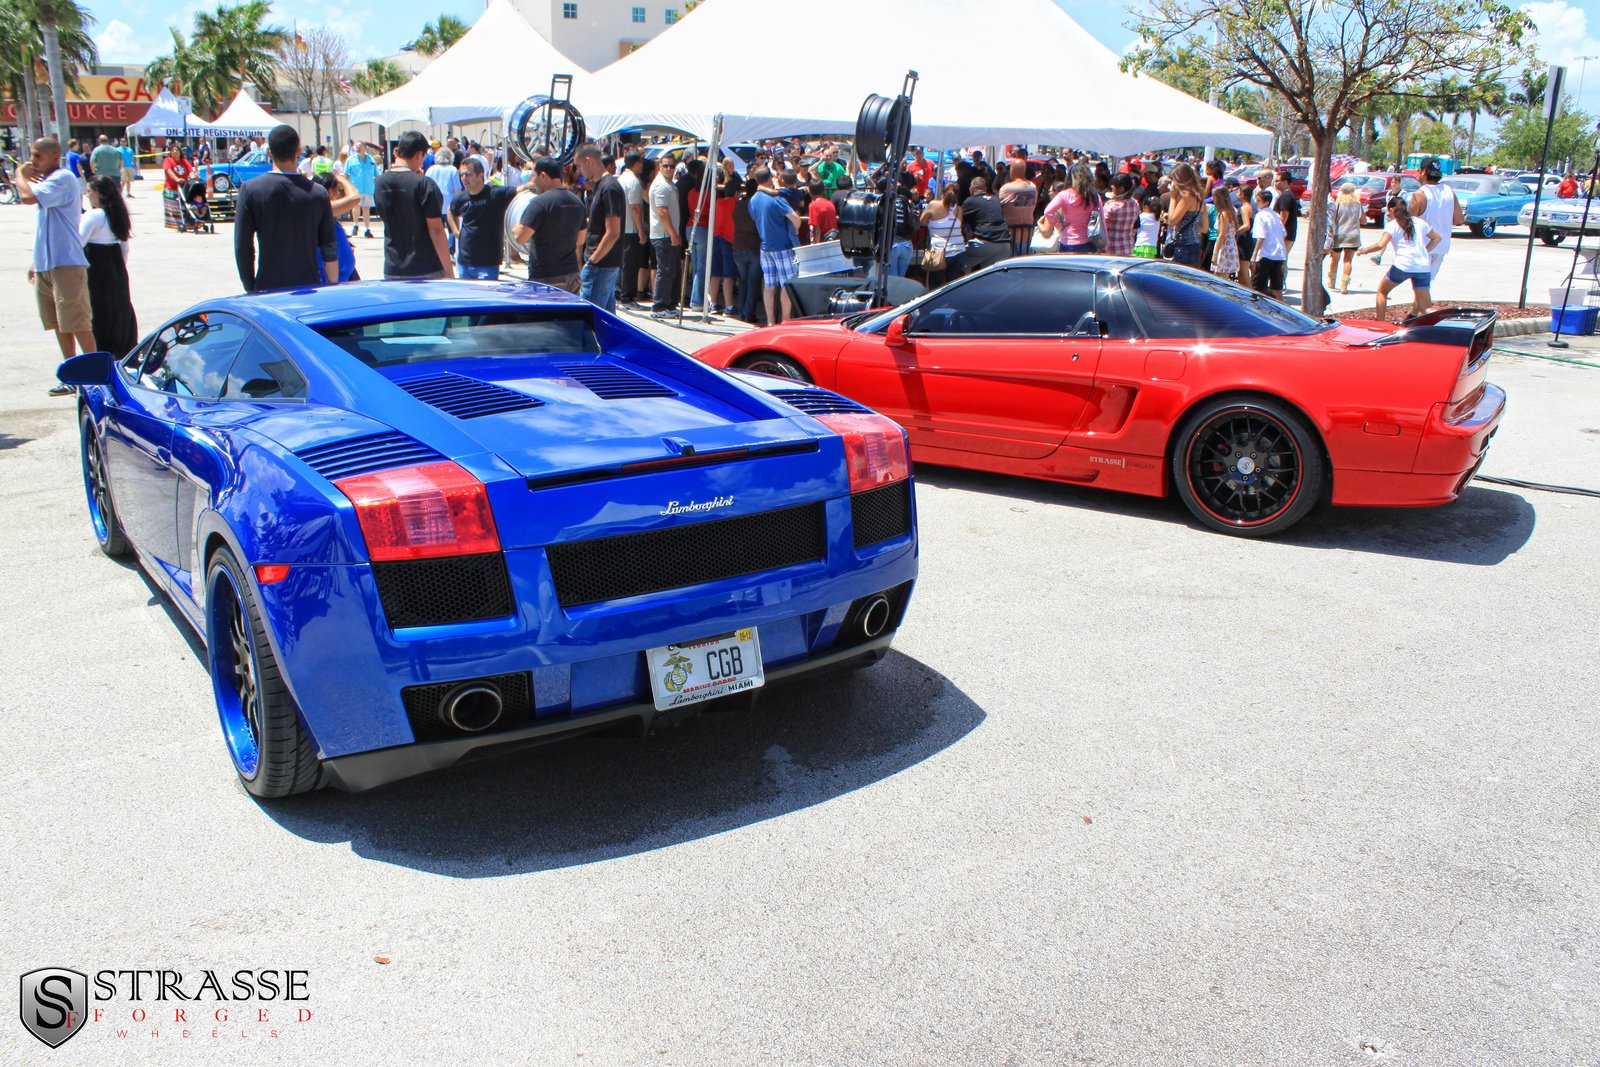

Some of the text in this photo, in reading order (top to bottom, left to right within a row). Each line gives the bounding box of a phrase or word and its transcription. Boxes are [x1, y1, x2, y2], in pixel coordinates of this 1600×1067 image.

[69, 104, 127, 120] UKEE
[166, 128, 263, 138] ON-SITE REGISTRATION
[1089, 456, 1123, 466] STRASSE
[659, 495, 735, 516] Lamborghini
[706, 646, 743, 680] CGB
[668, 679, 753, 707] Lamborghini MIAMI
